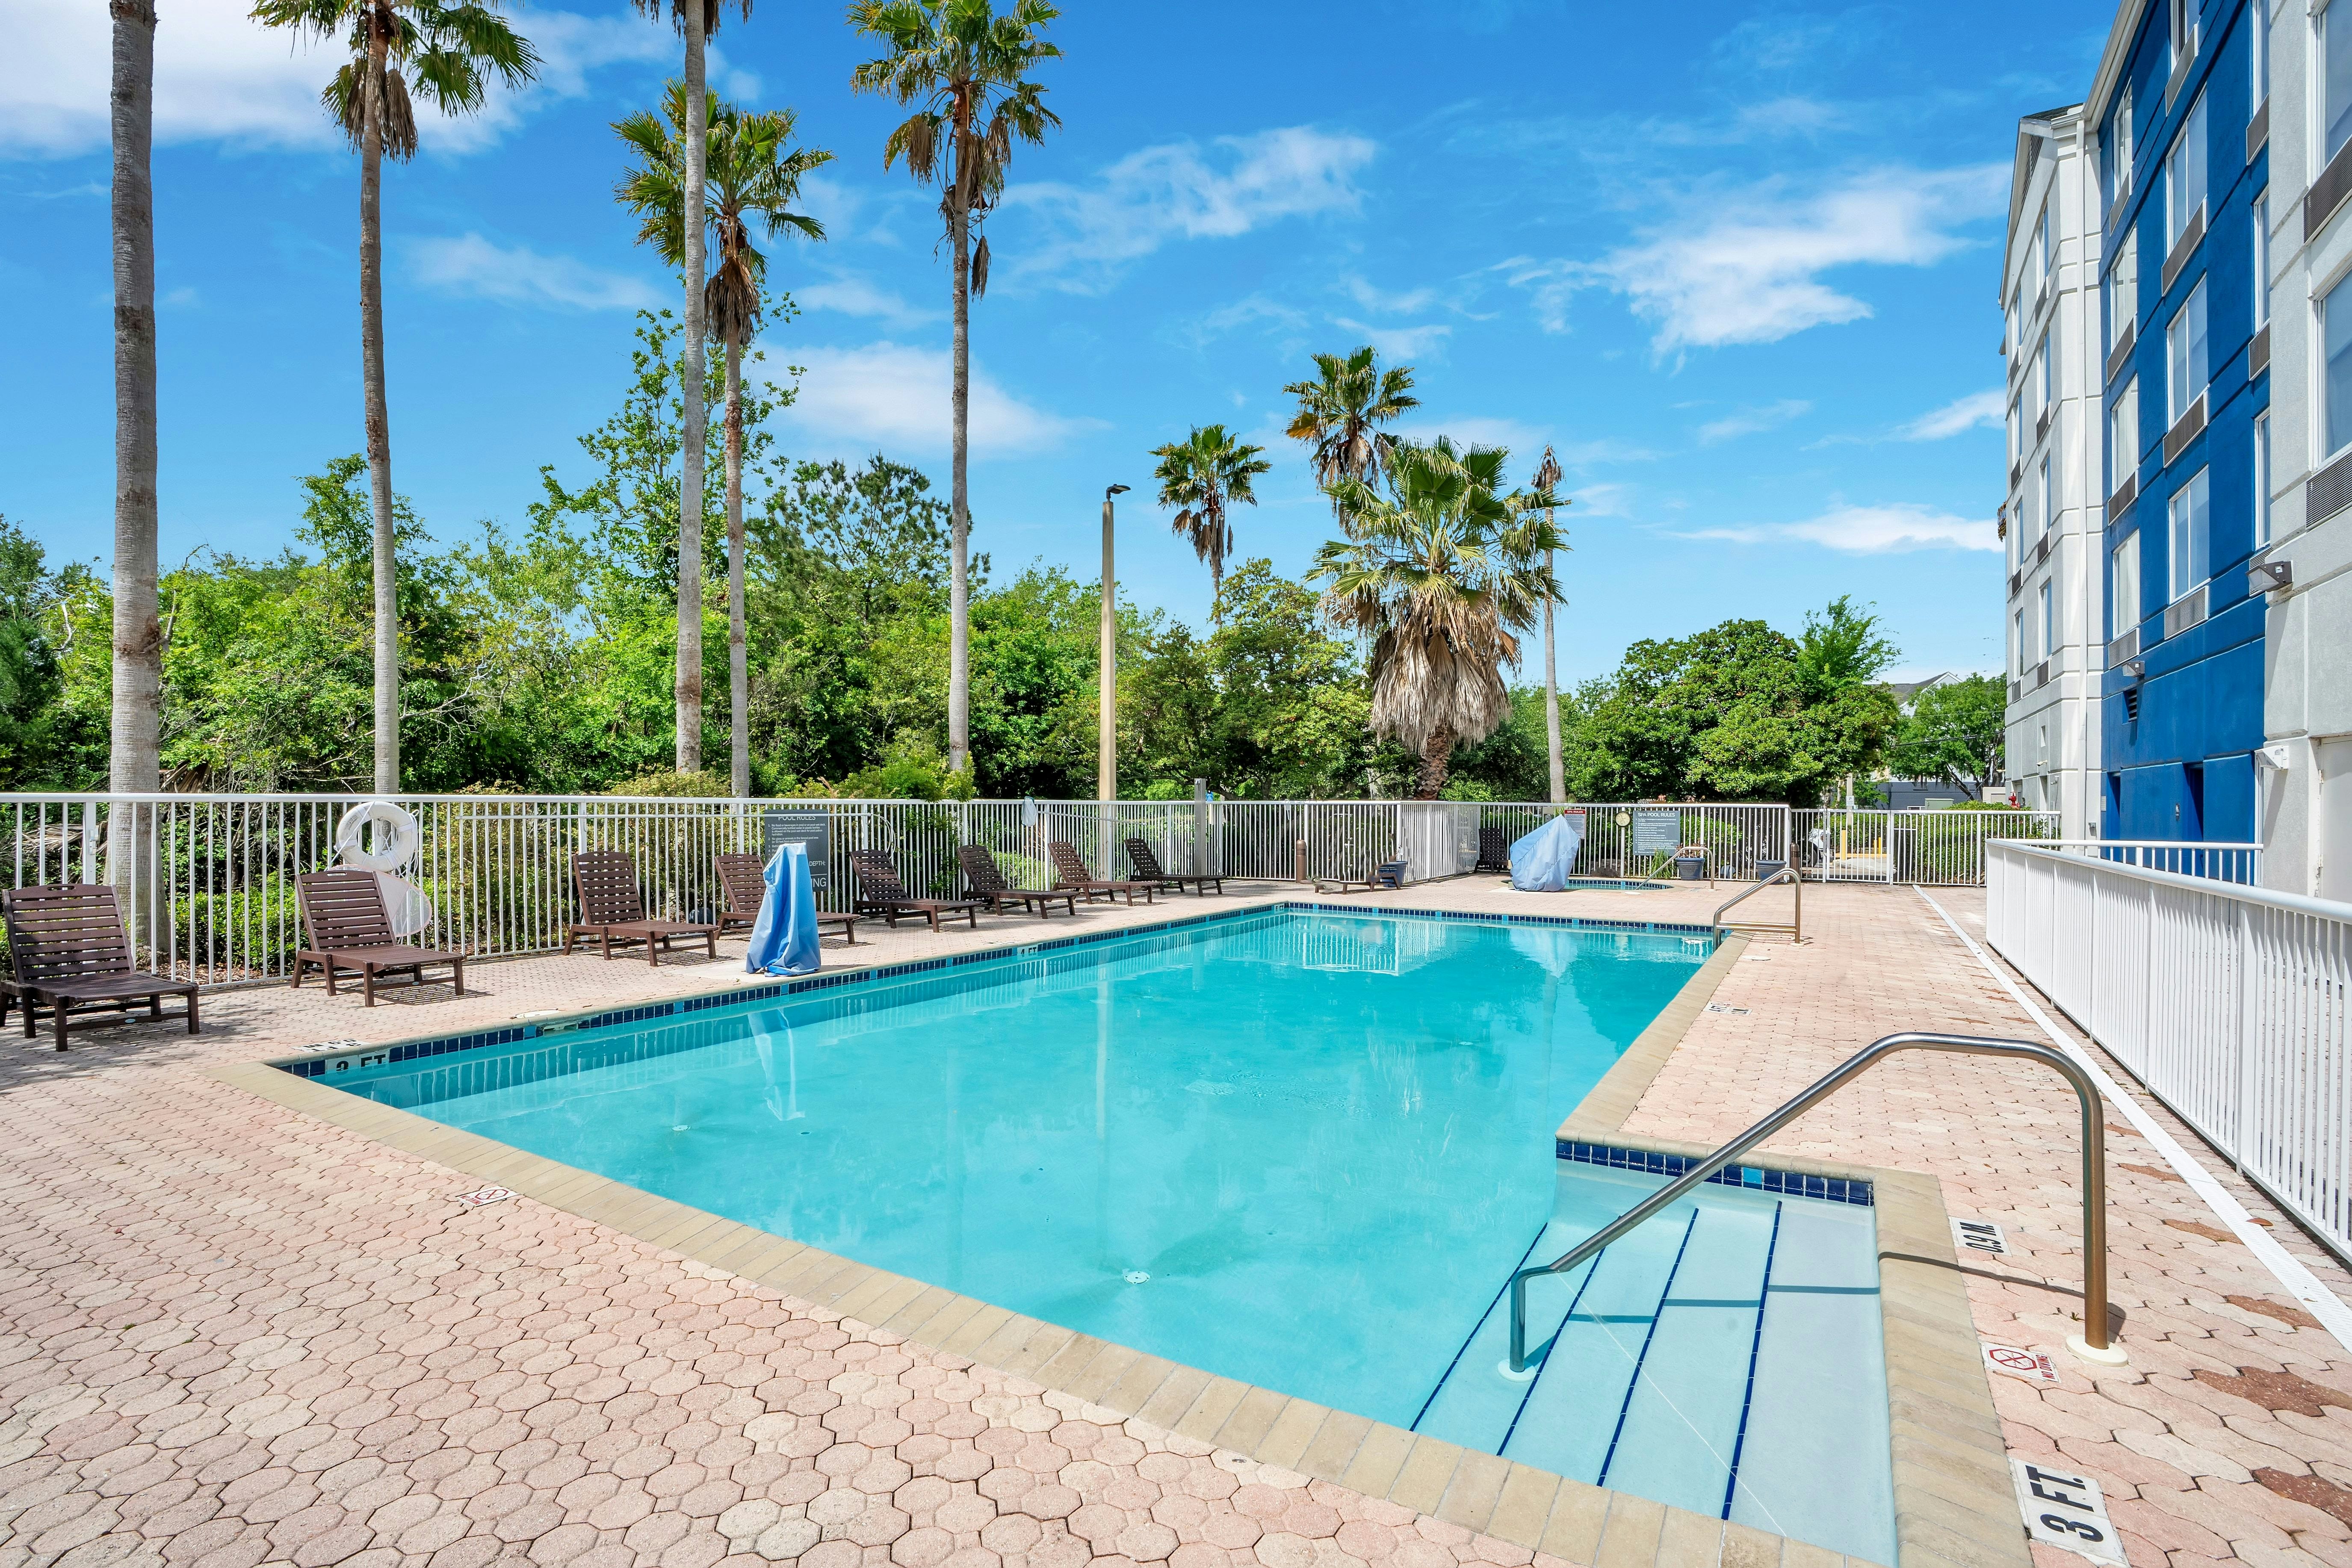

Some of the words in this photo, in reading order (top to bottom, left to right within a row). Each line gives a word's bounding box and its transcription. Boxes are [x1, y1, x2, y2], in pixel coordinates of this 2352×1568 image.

[361, 1054, 386, 1068] FT
[1959, 1222, 1997, 1236] M.
[1963, 1235, 2004, 1253] 0.9
[2036, 1355, 2053, 1371] DIVING
[2041, 1371, 2055, 1379] NO
[2025, 1465, 2094, 1512] FT.
[2040, 1514, 2104, 1542] 3
